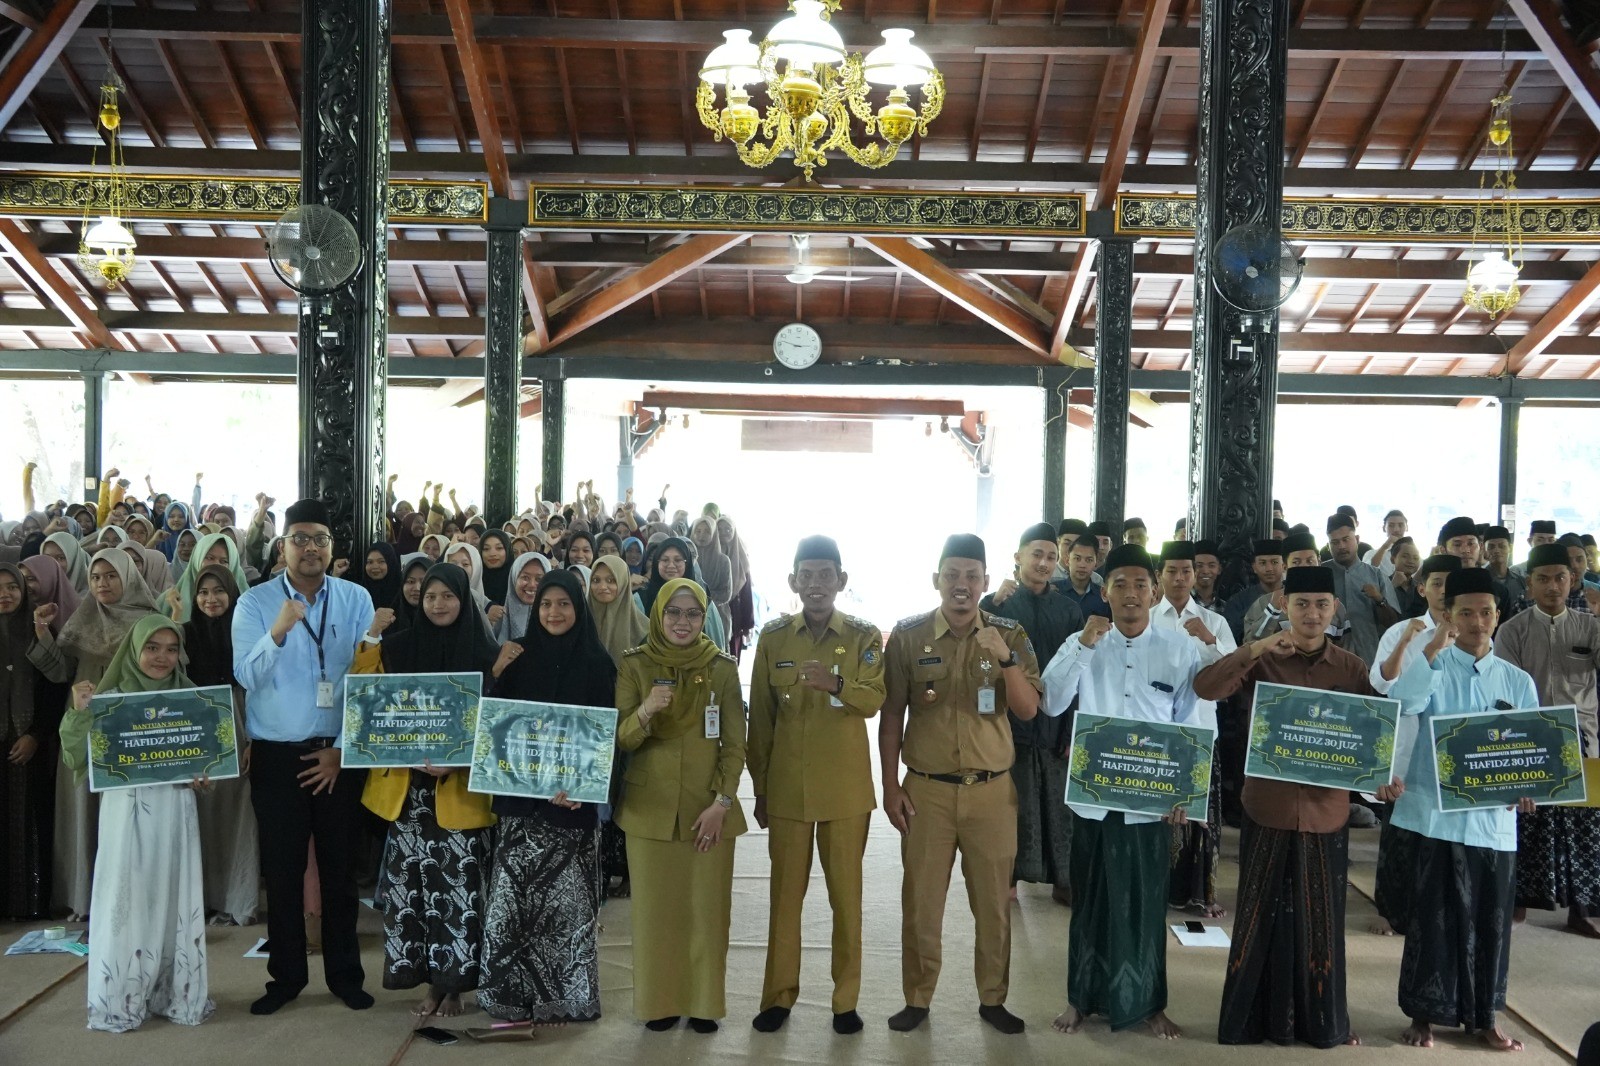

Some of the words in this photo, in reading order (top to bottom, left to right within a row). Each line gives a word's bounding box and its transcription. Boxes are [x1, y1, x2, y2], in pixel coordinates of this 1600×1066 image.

[133, 721, 167, 729] BANTUAN
[427, 719, 447, 728] JUZ
[1294, 719, 1327, 729] BANTUAN
[1329, 723, 1353, 732] SOSIAL
[125, 737, 165, 748] HAFIDZ
[167, 736, 179, 744] 30
[179, 734, 200, 744] JUZ
[369, 734, 386, 743] Rp.
[1283, 733, 1323, 745] HAFIDZ
[1324, 738, 1337, 746] 30
[1336, 740, 1357, 750] JUZ
[1113, 747, 1145, 756] BANTUAN
[1147, 751, 1170, 759] SOSIAL
[1274, 745, 1292, 757] Rp.
[1477, 743, 1510, 751] BANTUAN
[118, 754, 137, 764] Rp.
[508, 748, 544, 757] HAFIDZ
[558, 752, 577, 761] JUZ
[498, 759, 513, 770] Rp
[1470, 759, 1510, 769] HAFIDZ
[1512, 758, 1524, 766] 30
[1524, 756, 1545, 767] JUZ
[1103, 761, 1142, 773] HAFIDZ
[1143, 766, 1155, 774] 30
[1155, 767, 1175, 778] JUZ
[1094, 773, 1111, 785] Rp.
[1464, 775, 1482, 786] Rp.
